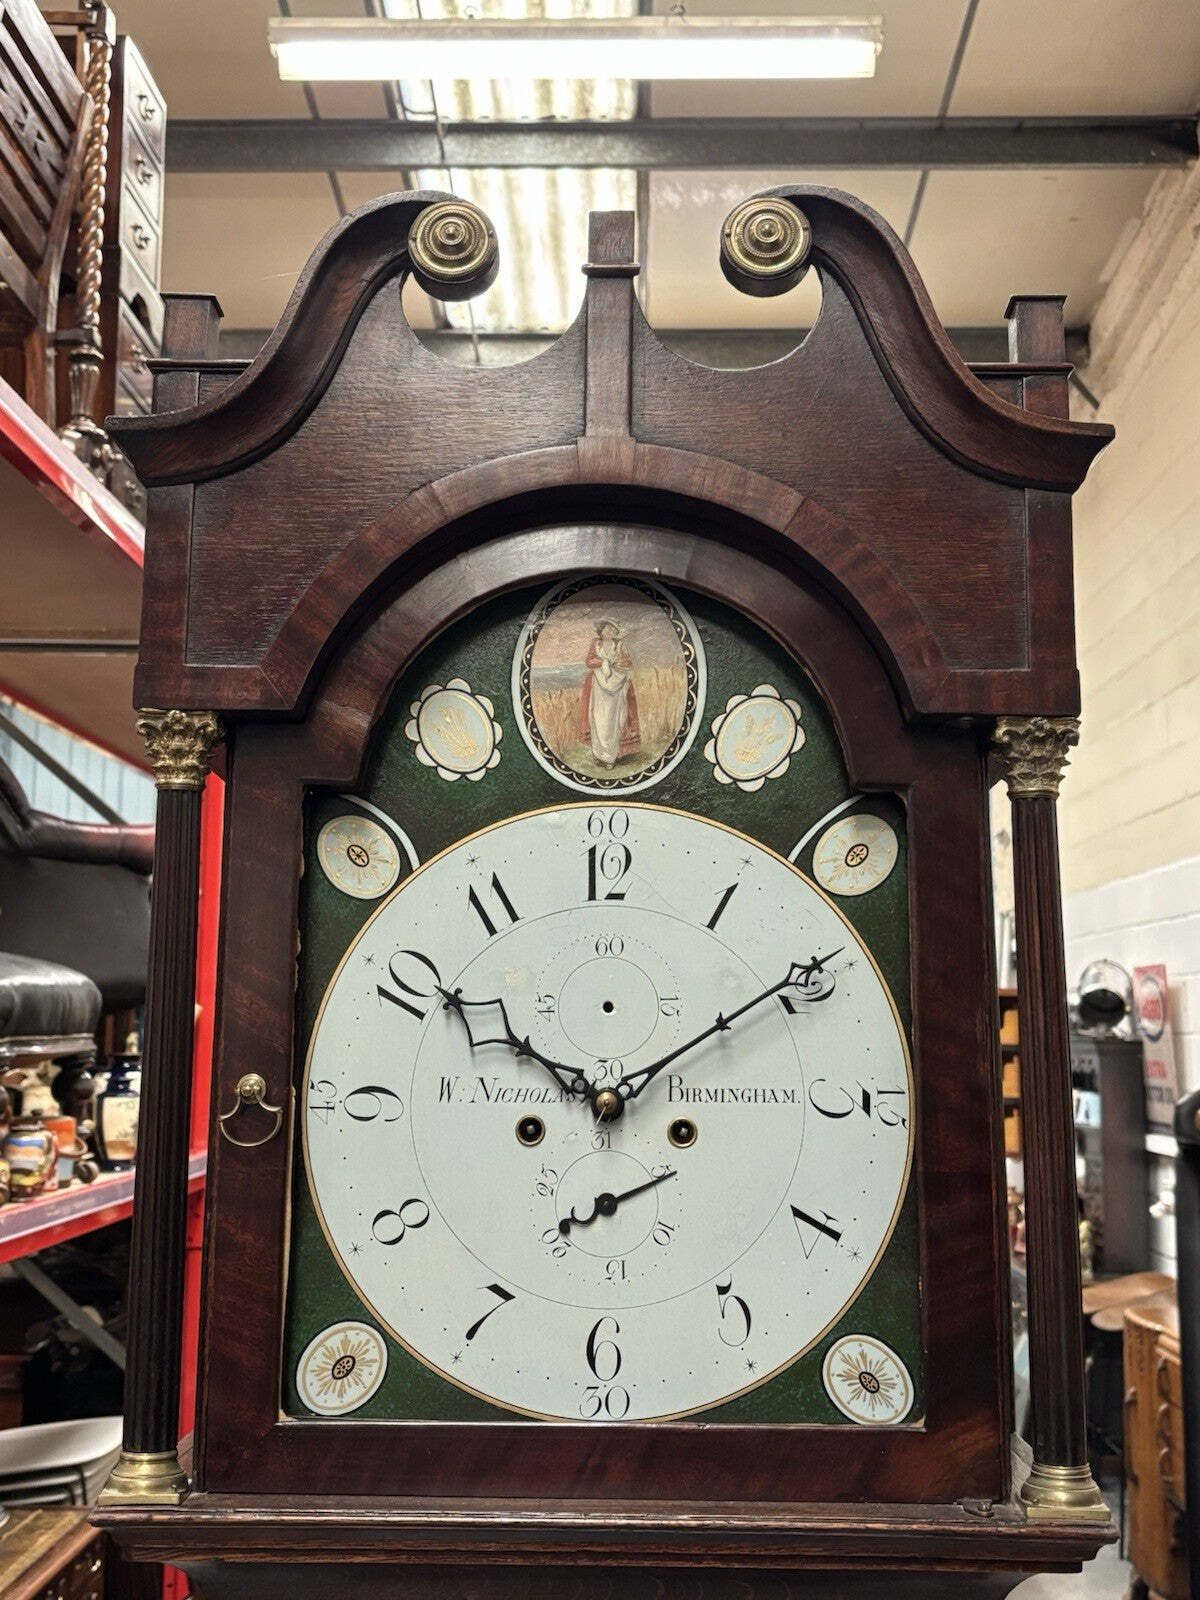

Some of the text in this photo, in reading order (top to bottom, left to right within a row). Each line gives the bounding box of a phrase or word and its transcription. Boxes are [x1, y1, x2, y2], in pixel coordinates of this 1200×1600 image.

[587, 808, 630, 839] 60
[579, 842, 634, 902] 12
[467, 871, 525, 938] 11
[700, 881, 740, 934] 1
[594, 935, 624, 957] 60
[376, 949, 442, 1025] 10
[536, 992, 556, 1023] 45
[659, 994, 681, 1017] 15
[777, 966, 836, 1015] 2
[593, 1058, 624, 1081] 30
[309, 1079, 338, 1126] 45
[343, 1085, 405, 1122] 9
[808, 1078, 872, 1119] 3
[876, 1085, 909, 1130] 15
[591, 1129, 612, 1151] 31
[535, 1163, 559, 1198] 25
[371, 1198, 430, 1246] 8
[652, 1220, 676, 1247] 10
[790, 1204, 844, 1260] 4
[604, 1259, 627, 1281] 15
[465, 1283, 516, 1341] 7
[715, 1273, 752, 1347] 5
[585, 1316, 622, 1382] 6
[579, 1386, 630, 1419] 30
